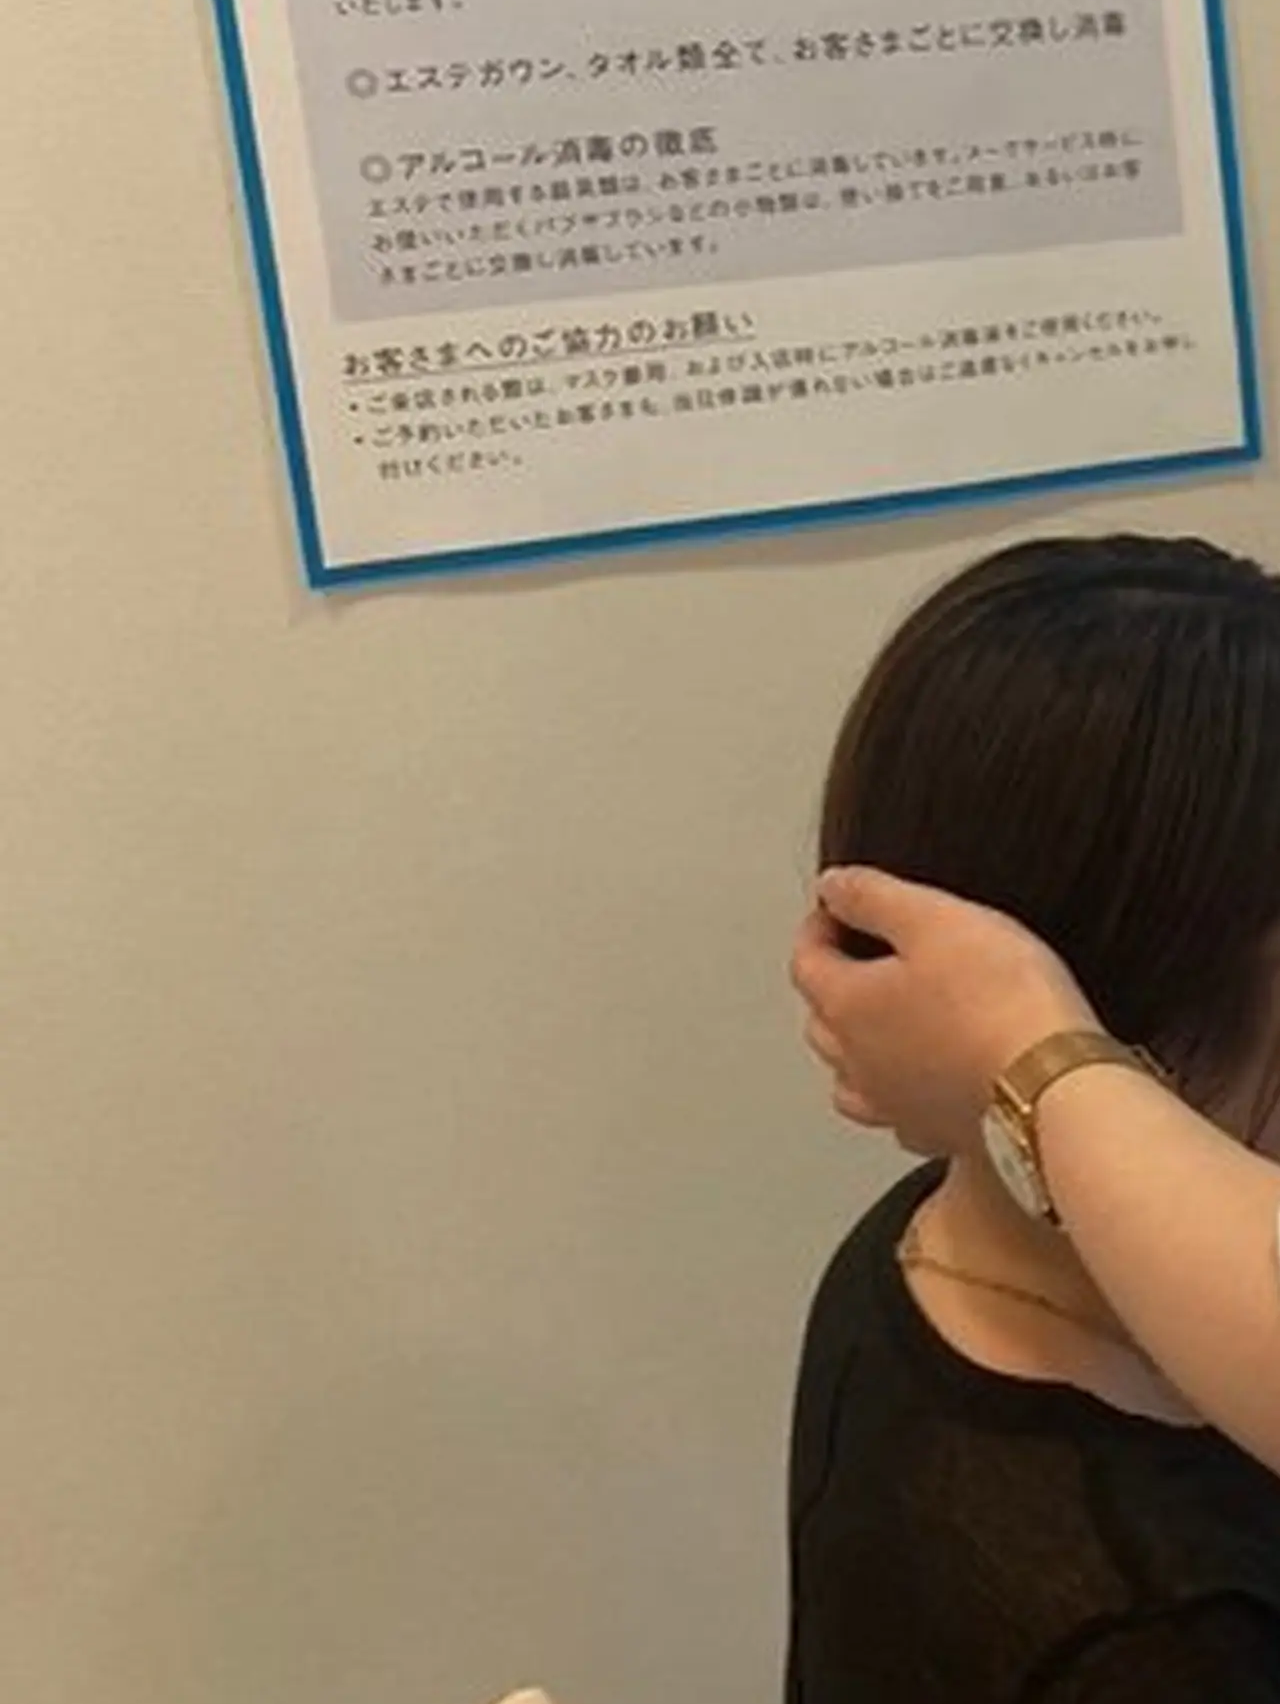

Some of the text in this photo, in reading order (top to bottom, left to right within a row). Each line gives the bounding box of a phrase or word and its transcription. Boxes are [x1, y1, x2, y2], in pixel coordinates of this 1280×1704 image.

[344, 311, 753, 376] お客さまへのご協力のお願い
